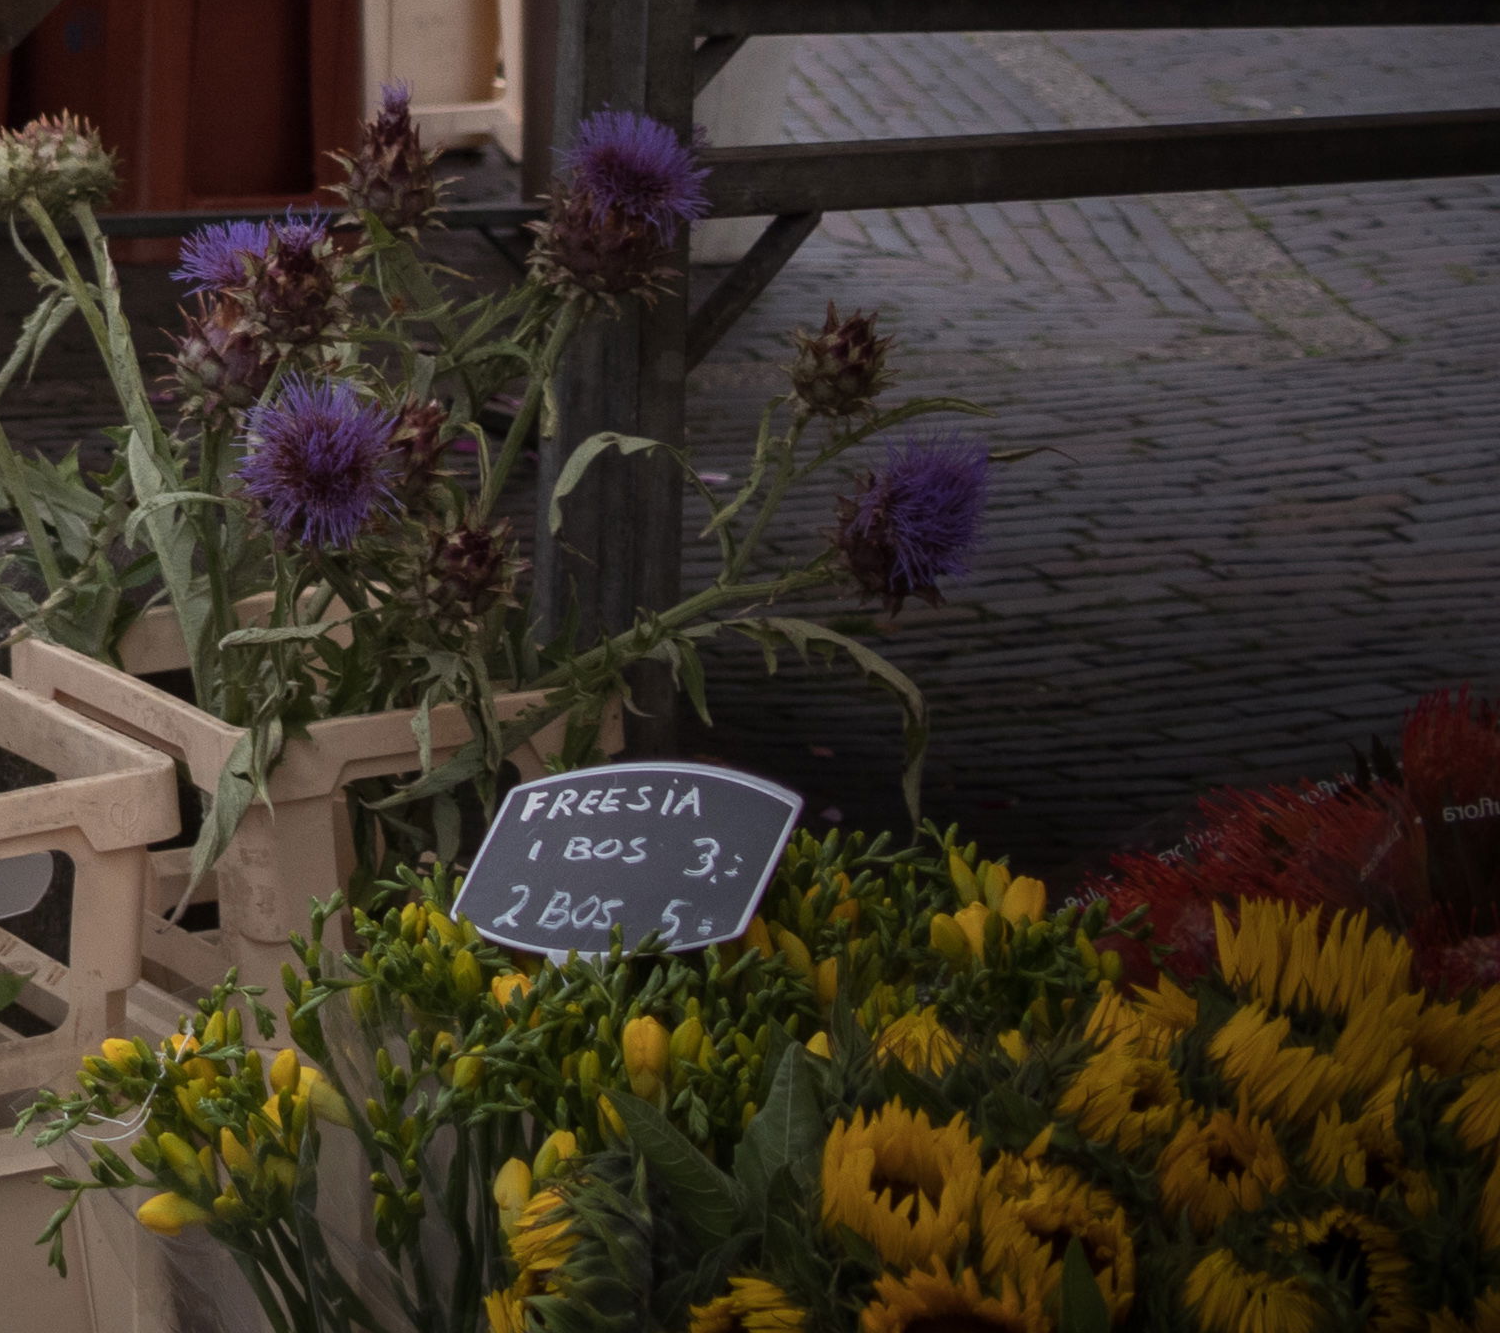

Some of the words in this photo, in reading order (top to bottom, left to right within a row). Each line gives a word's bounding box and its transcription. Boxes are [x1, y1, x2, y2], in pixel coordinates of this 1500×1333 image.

[563, 836, 647, 864] BOS
[492, 884, 530, 928] 2
[537, 890, 624, 931] BOS
